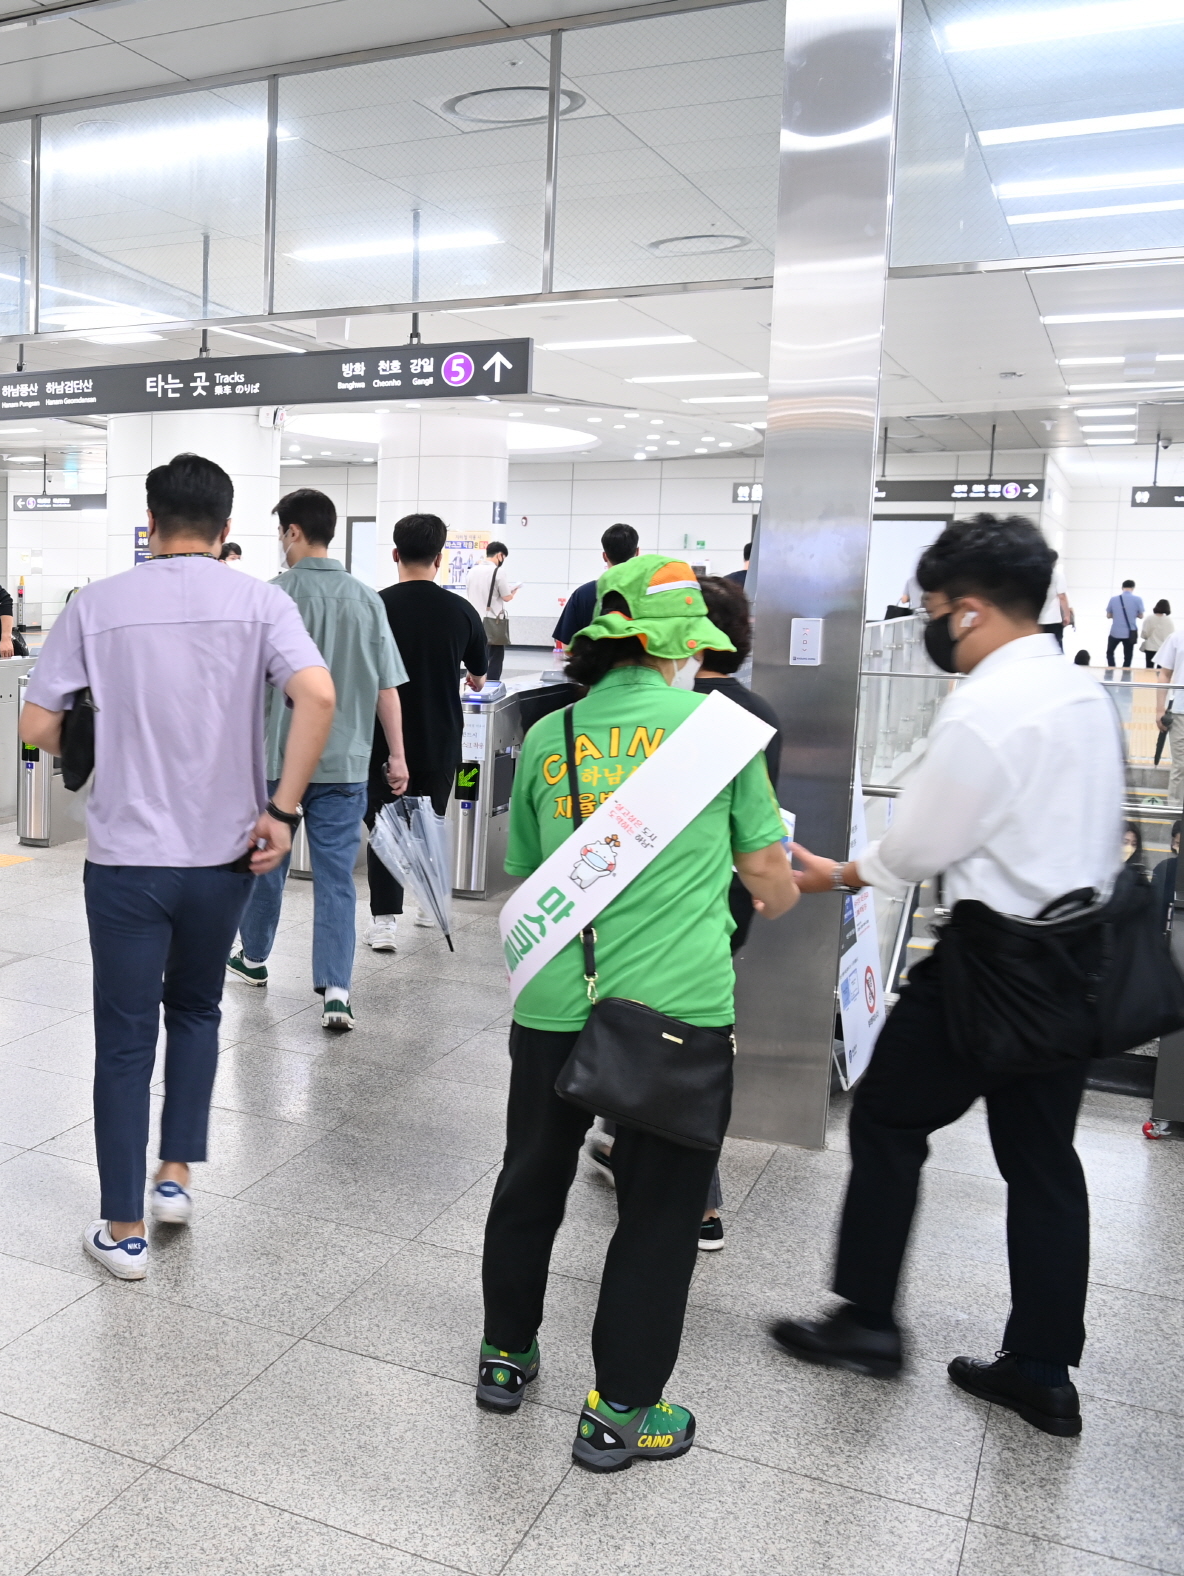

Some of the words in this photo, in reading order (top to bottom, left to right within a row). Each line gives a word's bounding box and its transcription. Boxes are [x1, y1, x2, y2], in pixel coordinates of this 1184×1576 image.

[342, 362, 366, 378] 방화
[378, 360, 402, 375] 천호
[410, 358, 434, 373] 강일
[146, 374, 184, 398] 타는
[190, 372, 210, 396] 곳
[214, 372, 245, 384] Tracks
[337, 380, 366, 390] Banghwa
[372, 378, 402, 388] Cheonho
[412, 376, 434, 386] Gangil
[2, 382, 38, 398] 하남풍산
[46, 379, 93, 394] 하남검단산
[235, 382, 260, 394] のりば
[19, 400, 40, 408] Pungsan
[46, 398, 63, 406] Hanam
[608, 810, 634, 836] 도약하는
[641, 826, 658, 842] 도시
[128, 1242, 142, 1250] NIKE
[638, 1434, 674, 1448] CAIND
